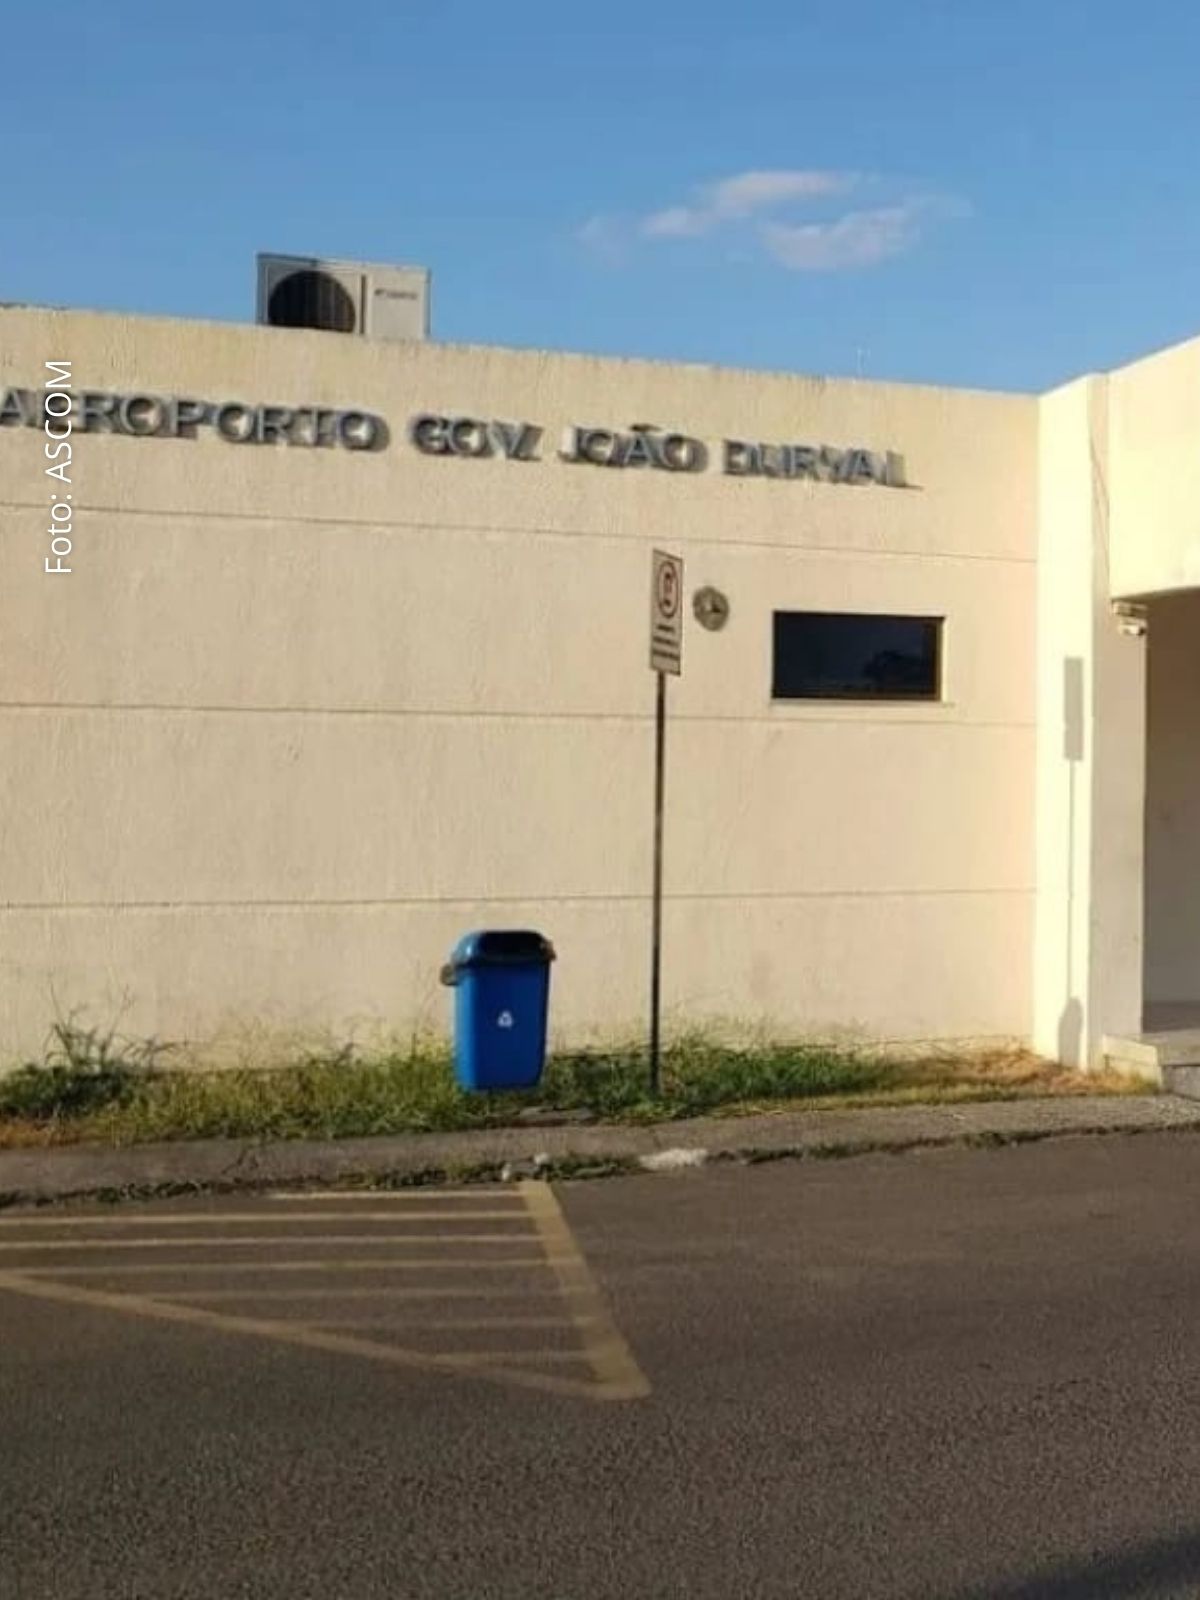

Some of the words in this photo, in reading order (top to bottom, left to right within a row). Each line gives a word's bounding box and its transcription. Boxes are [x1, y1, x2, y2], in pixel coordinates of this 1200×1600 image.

[0, 388, 389, 451] AEROPORTO
[558, 423, 707, 473] JOÃO
[724, 440, 921, 489] DURVAL
